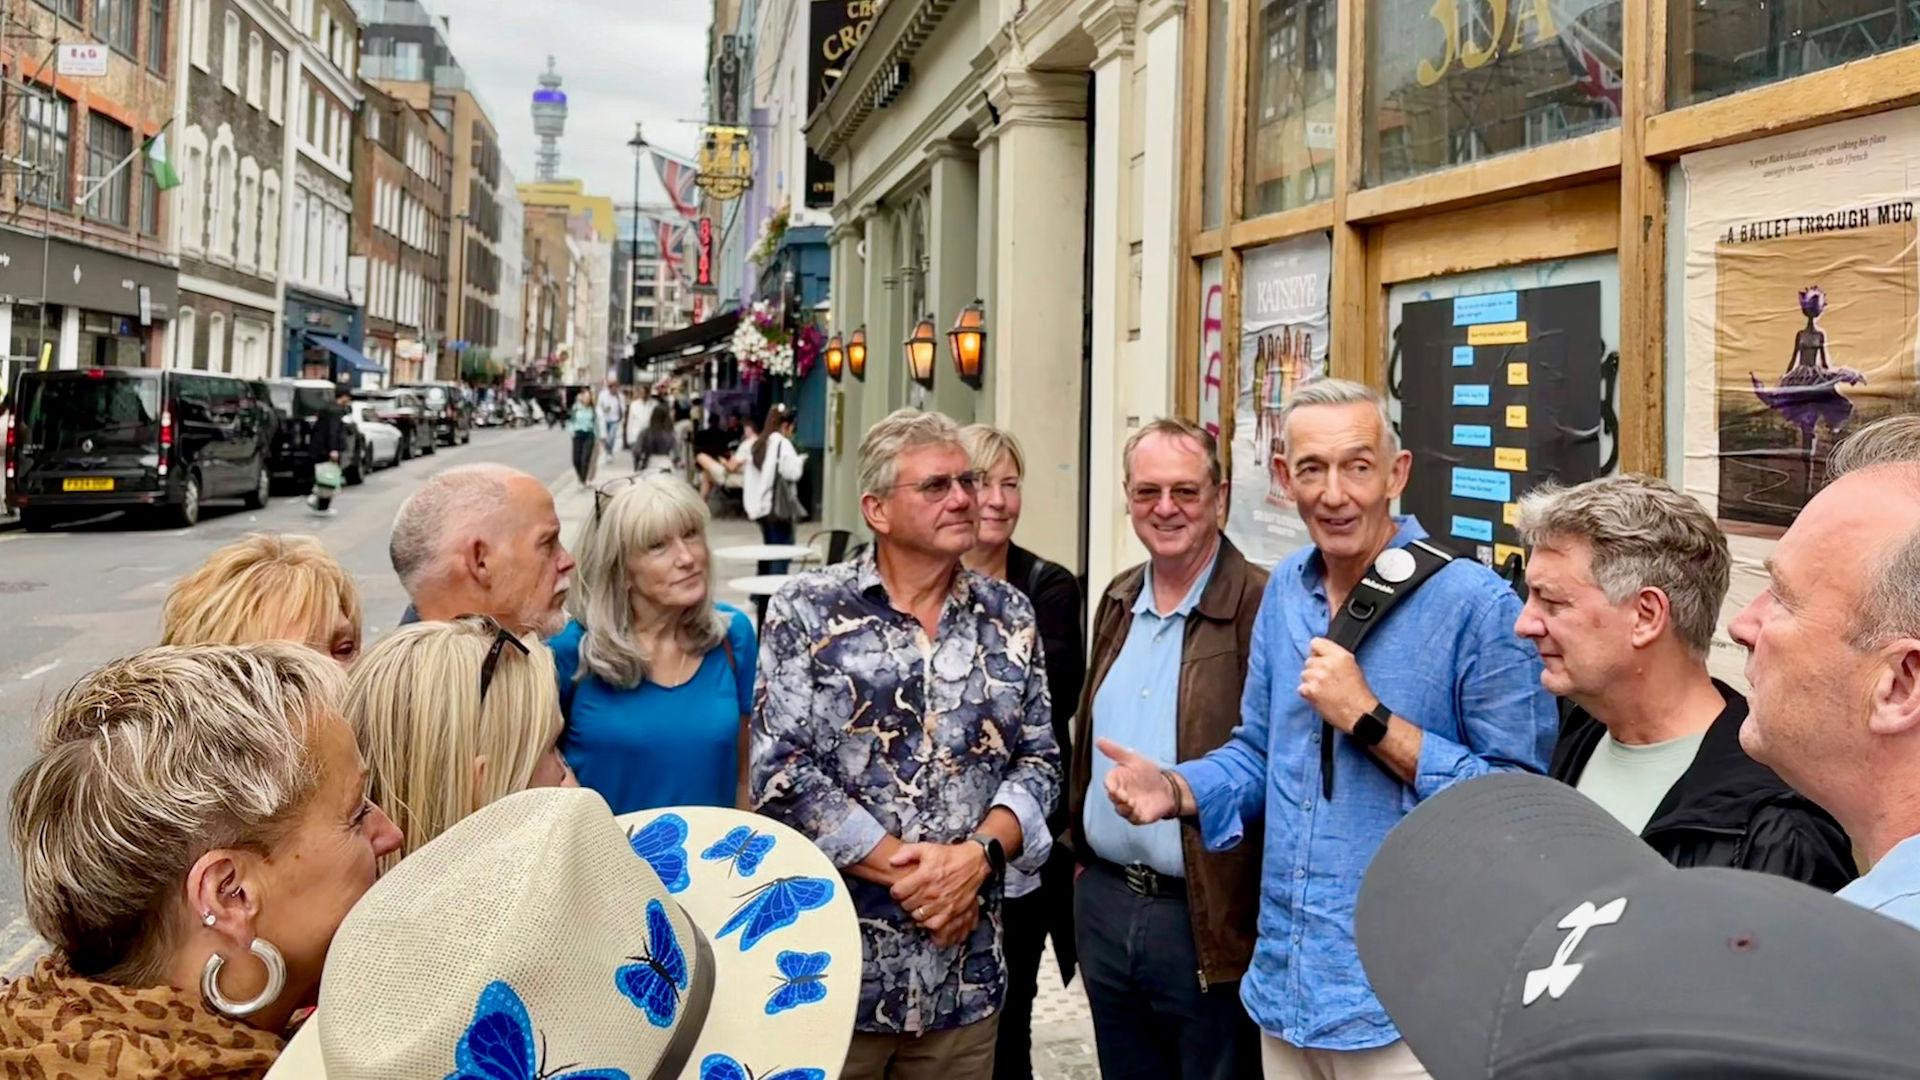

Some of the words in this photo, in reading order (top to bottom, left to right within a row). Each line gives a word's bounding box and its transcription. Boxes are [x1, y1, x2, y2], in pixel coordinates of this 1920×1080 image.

[822, 21, 871, 60] CRO
[1727, 226, 1735, 244] A
[1740, 219, 1790, 243] BALLET
[1877, 202, 1914, 225] MUD
[1256, 273, 1317, 314] KATSEYE
